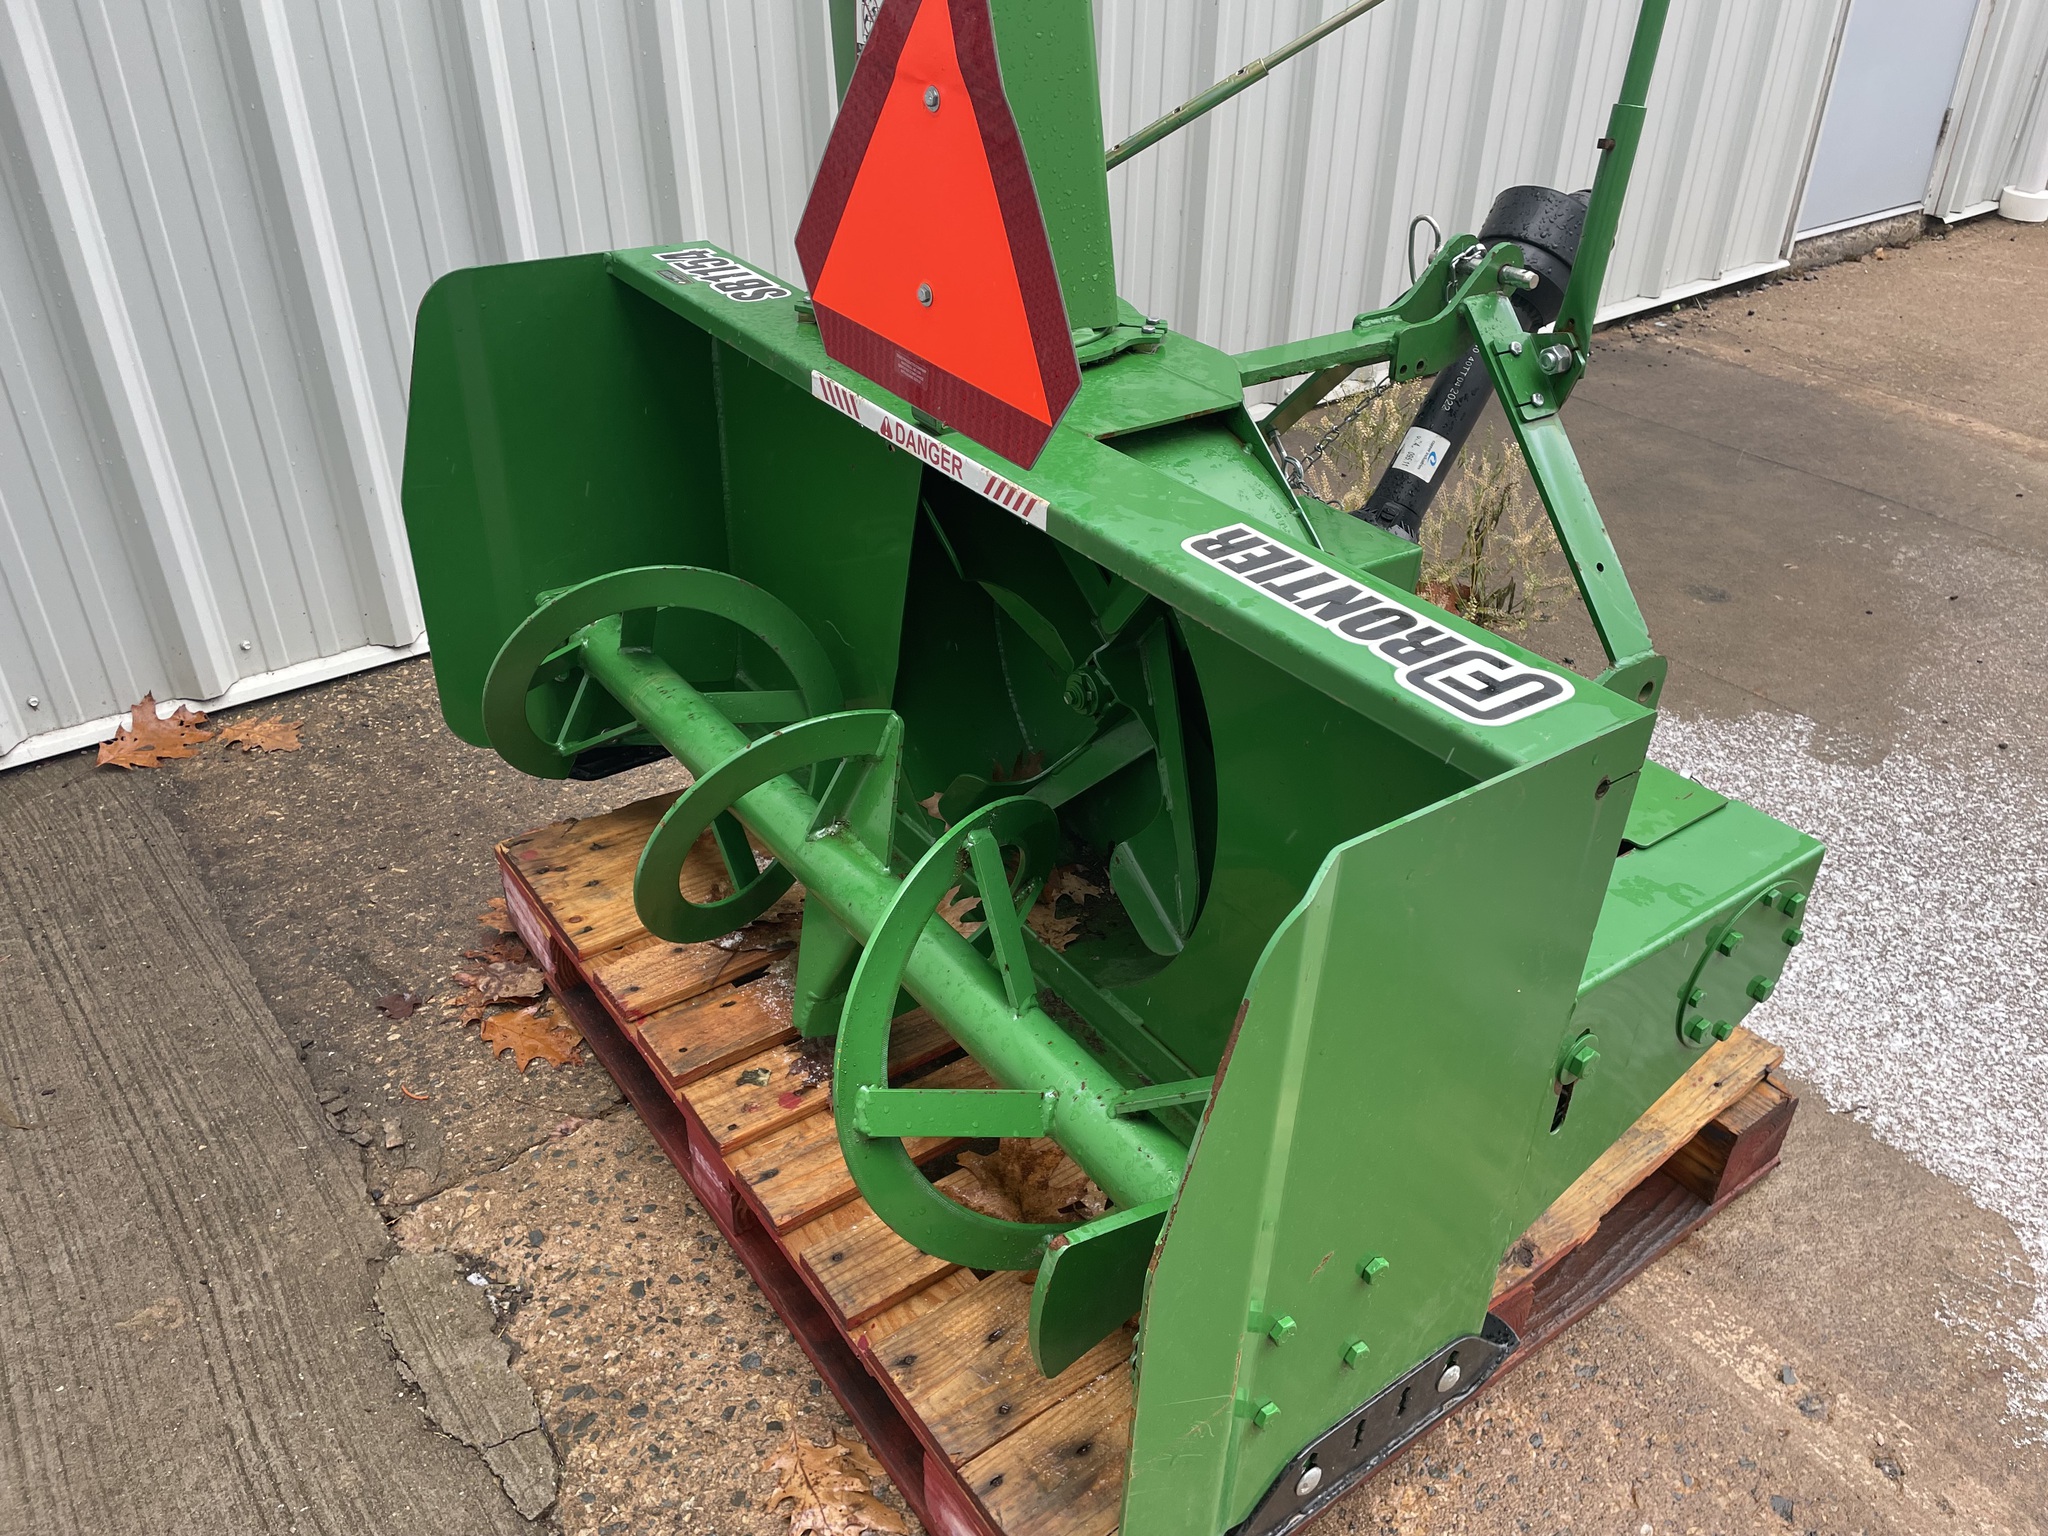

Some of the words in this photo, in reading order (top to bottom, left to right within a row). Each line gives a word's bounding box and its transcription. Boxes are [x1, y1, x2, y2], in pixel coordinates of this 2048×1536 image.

[659, 250, 788, 300] SB1154
[1441, 387, 1460, 411] 2022
[895, 421, 963, 480] DANGER
[1189, 527, 1565, 721] FRONTIER
